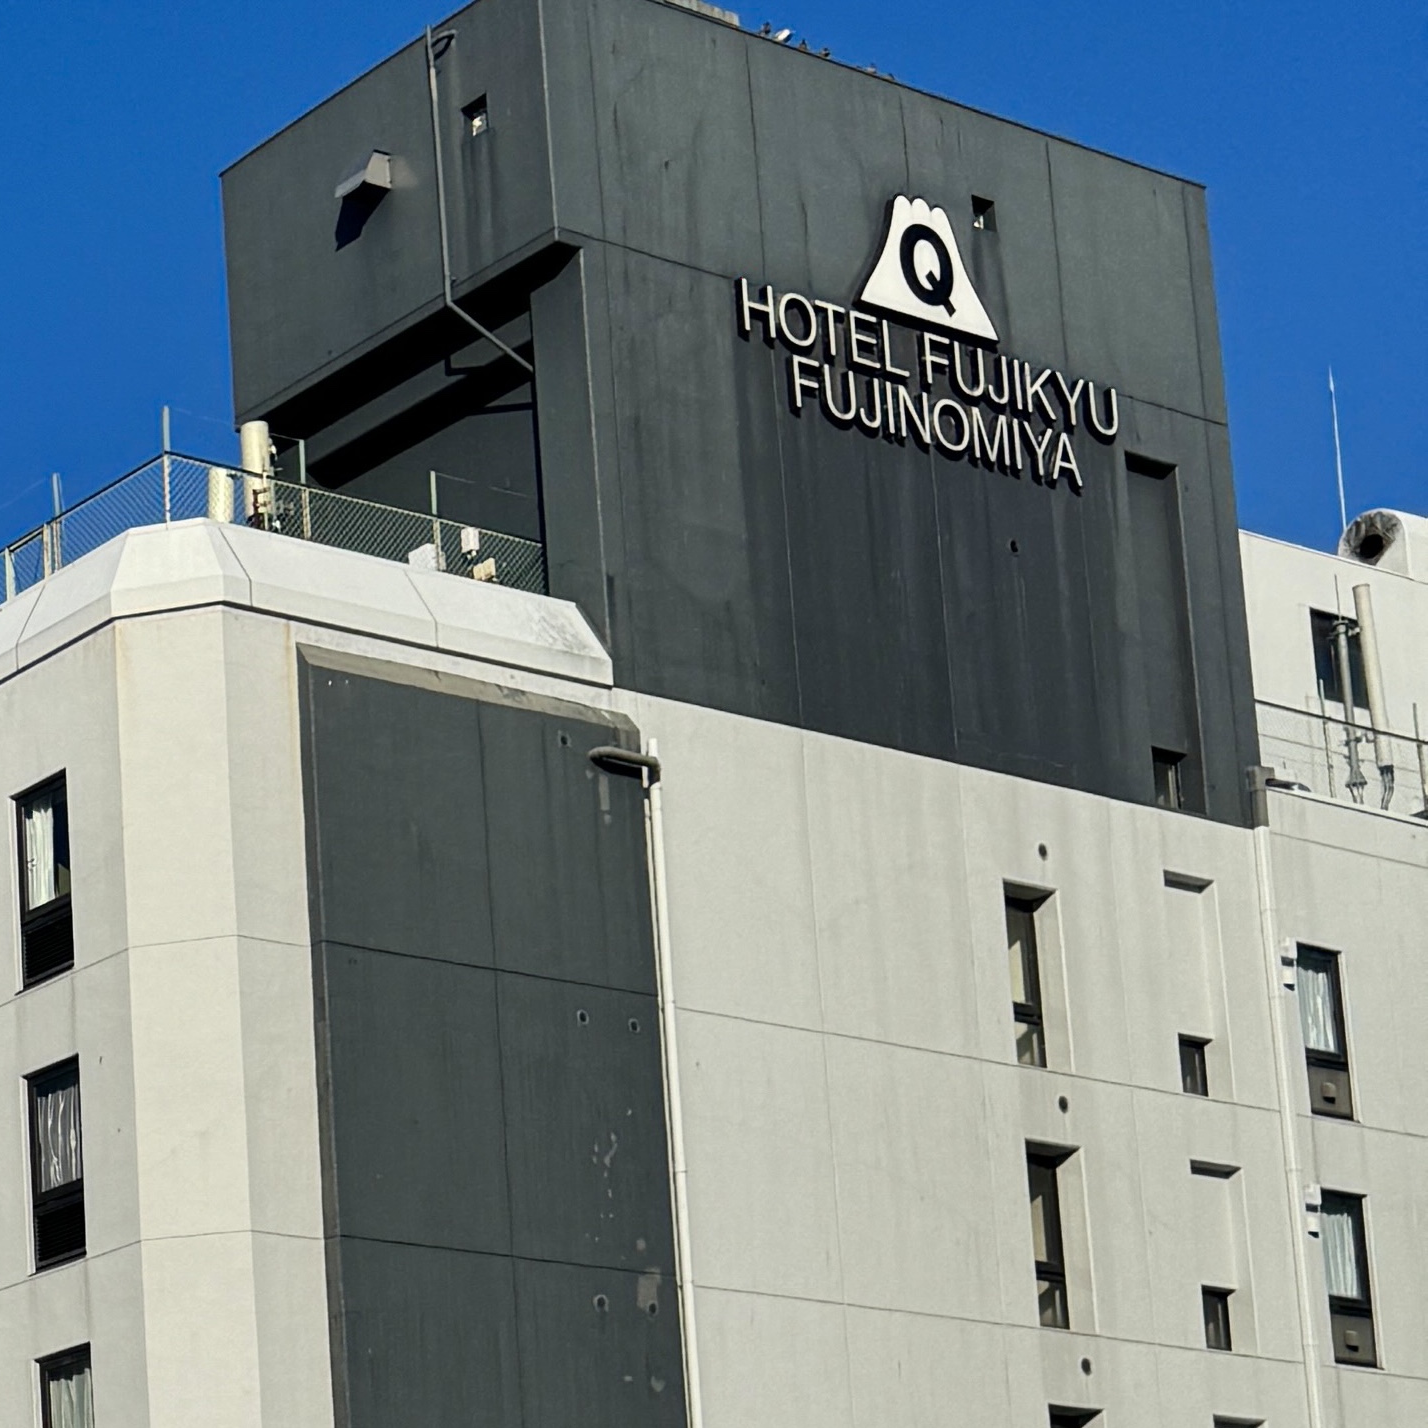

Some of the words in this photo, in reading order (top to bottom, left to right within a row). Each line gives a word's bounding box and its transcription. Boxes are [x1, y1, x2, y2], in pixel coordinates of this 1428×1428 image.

[899, 223, 956, 318] Q
[738, 277, 910, 379] HOTEL
[921, 331, 1119, 438] FUJIKYU
[790, 355, 1083, 489] FUJINOMIYA
